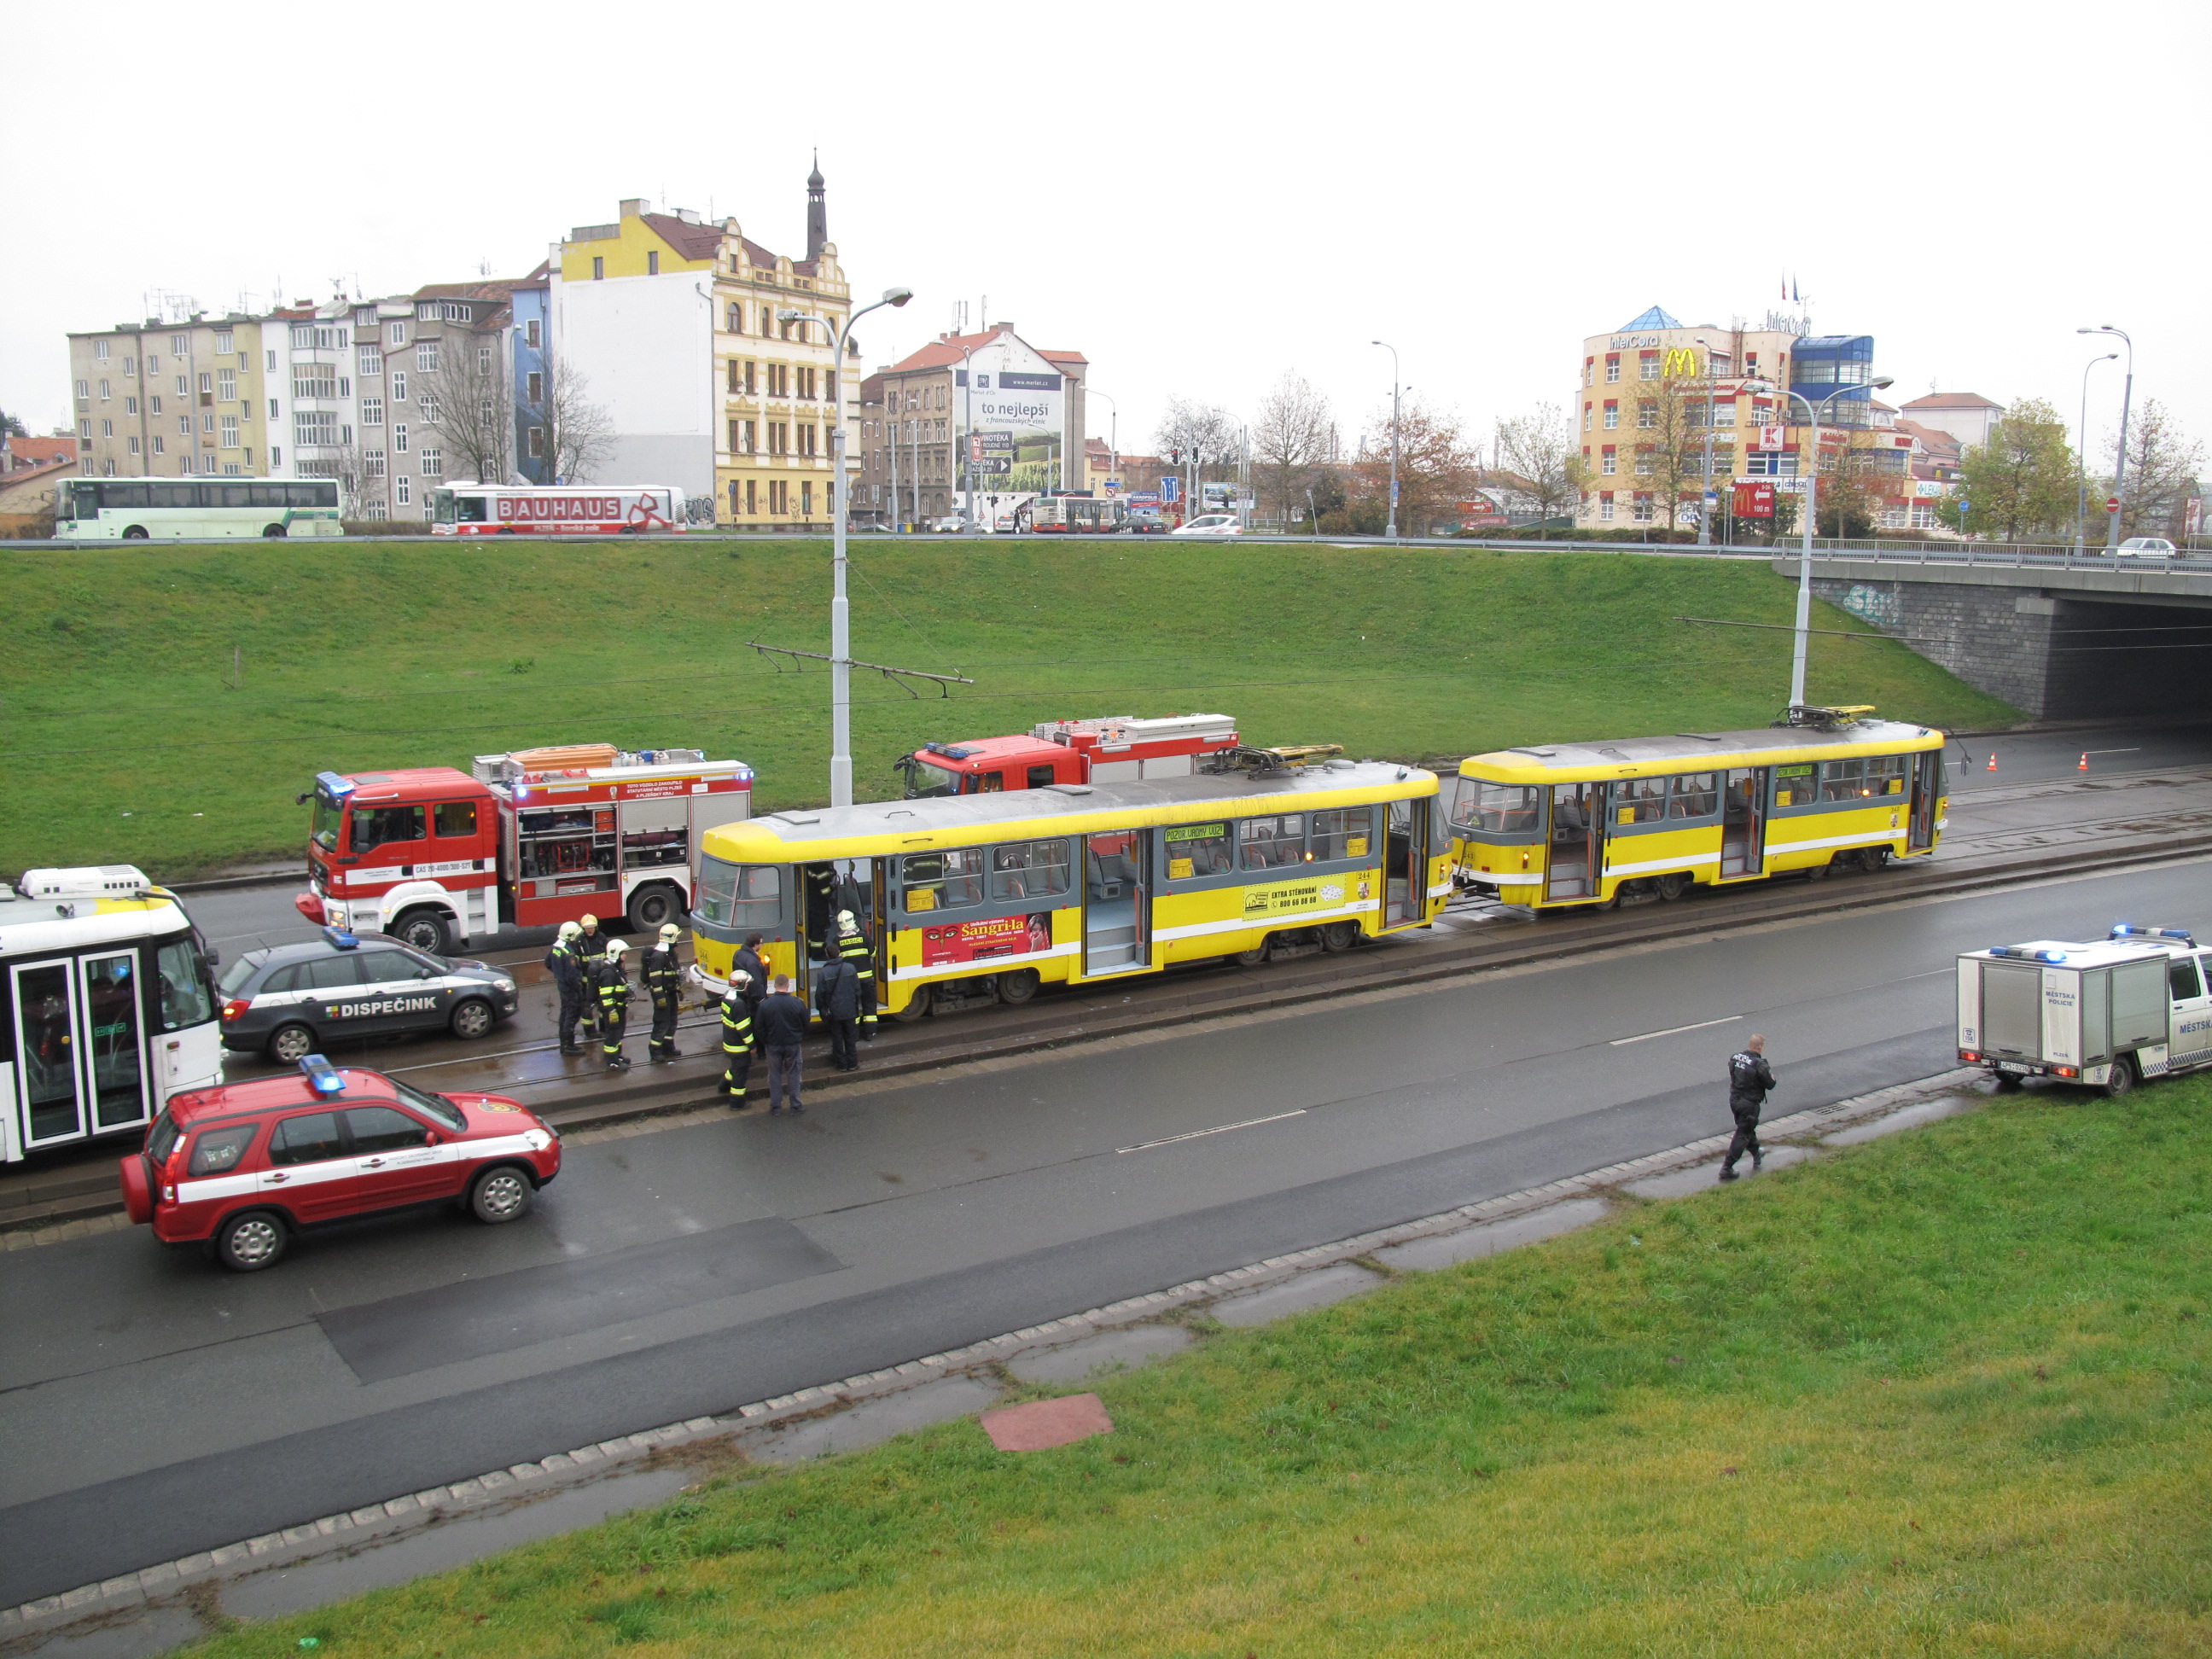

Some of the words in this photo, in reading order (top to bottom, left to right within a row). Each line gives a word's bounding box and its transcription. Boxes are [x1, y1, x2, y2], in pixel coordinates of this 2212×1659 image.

[981, 402, 995, 414] to
[998, 402, 1049, 418] nejlepší
[990, 416, 1030, 425] francouzských
[498, 498, 620, 519] BAUHAUS
[1272, 890, 1288, 899] EXTRA
[1280, 899, 1291, 908] 800
[961, 919, 1024, 937] Šangri-la
[2045, 991, 2075, 999] MĚSTSKÁ
[341, 997, 437, 1017] DISPEČINK
[2048, 998, 2073, 1007] POLICIE
